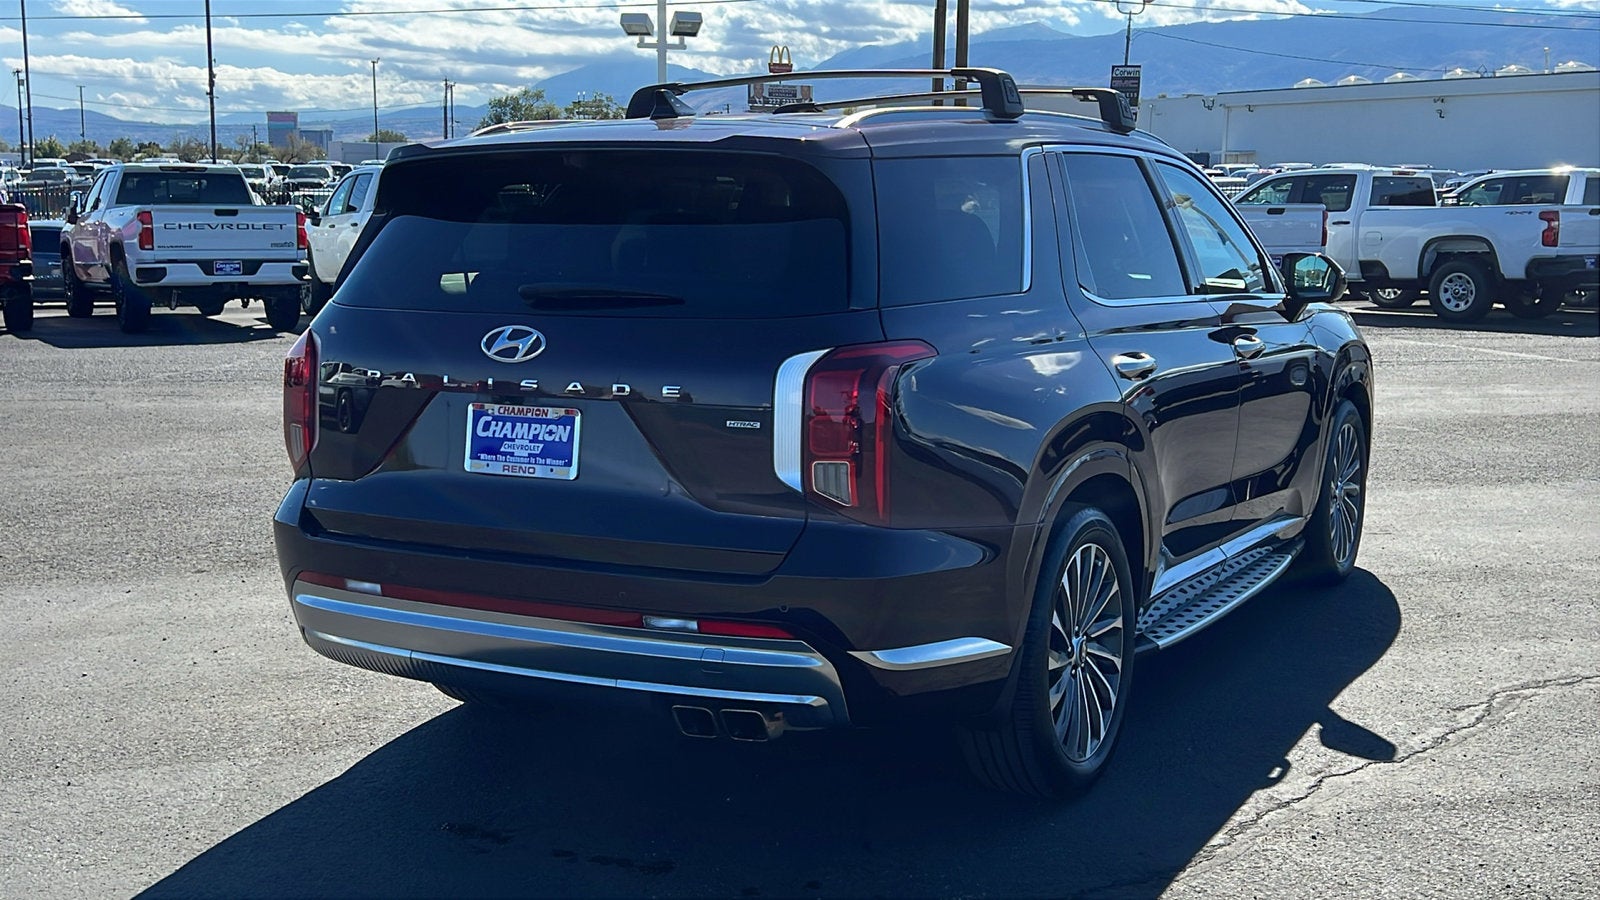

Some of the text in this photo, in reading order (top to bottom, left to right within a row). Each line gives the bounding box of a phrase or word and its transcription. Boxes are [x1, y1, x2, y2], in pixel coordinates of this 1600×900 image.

[1114, 68, 1140, 76] Corwin
[163, 222, 287, 231] CHEVROLET
[366, 369, 681, 398] PALISADE
[498, 405, 549, 418] CHAMPION
[476, 415, 571, 443] CHAMPION
[503, 442, 541, 453] CHEVROLET
[496, 454, 506, 462] The
[506, 455, 530, 464] Customer
[536, 457, 545, 465] The
[502, 464, 536, 475] RENO
